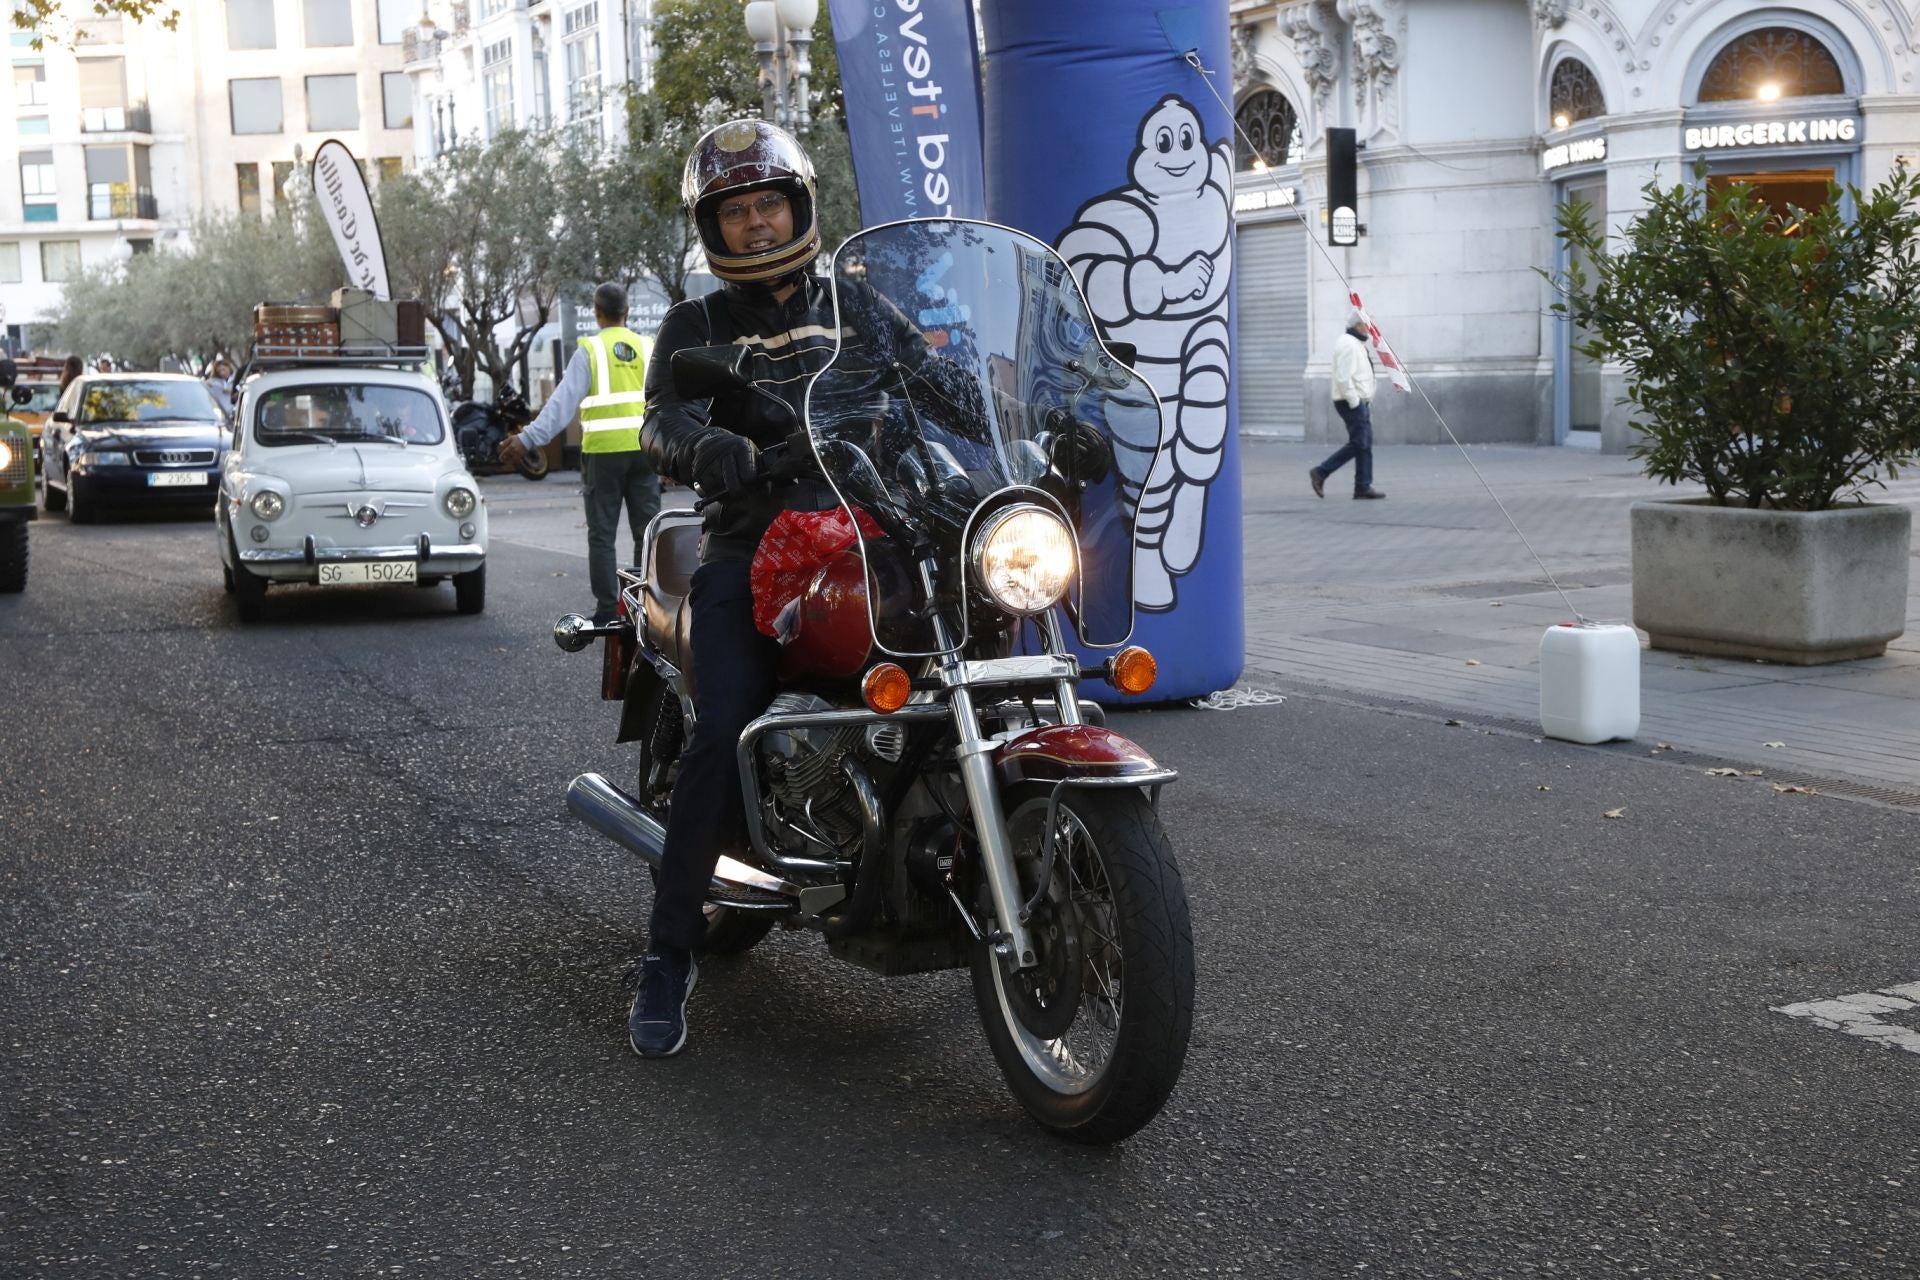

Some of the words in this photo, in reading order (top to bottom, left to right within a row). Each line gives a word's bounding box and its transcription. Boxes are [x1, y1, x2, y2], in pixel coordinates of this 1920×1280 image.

[1685, 122, 1785, 149] BURGER
[1788, 119, 1856, 142] KING
[321, 566, 342, 581] SG
[364, 563, 414, 580] 15024
